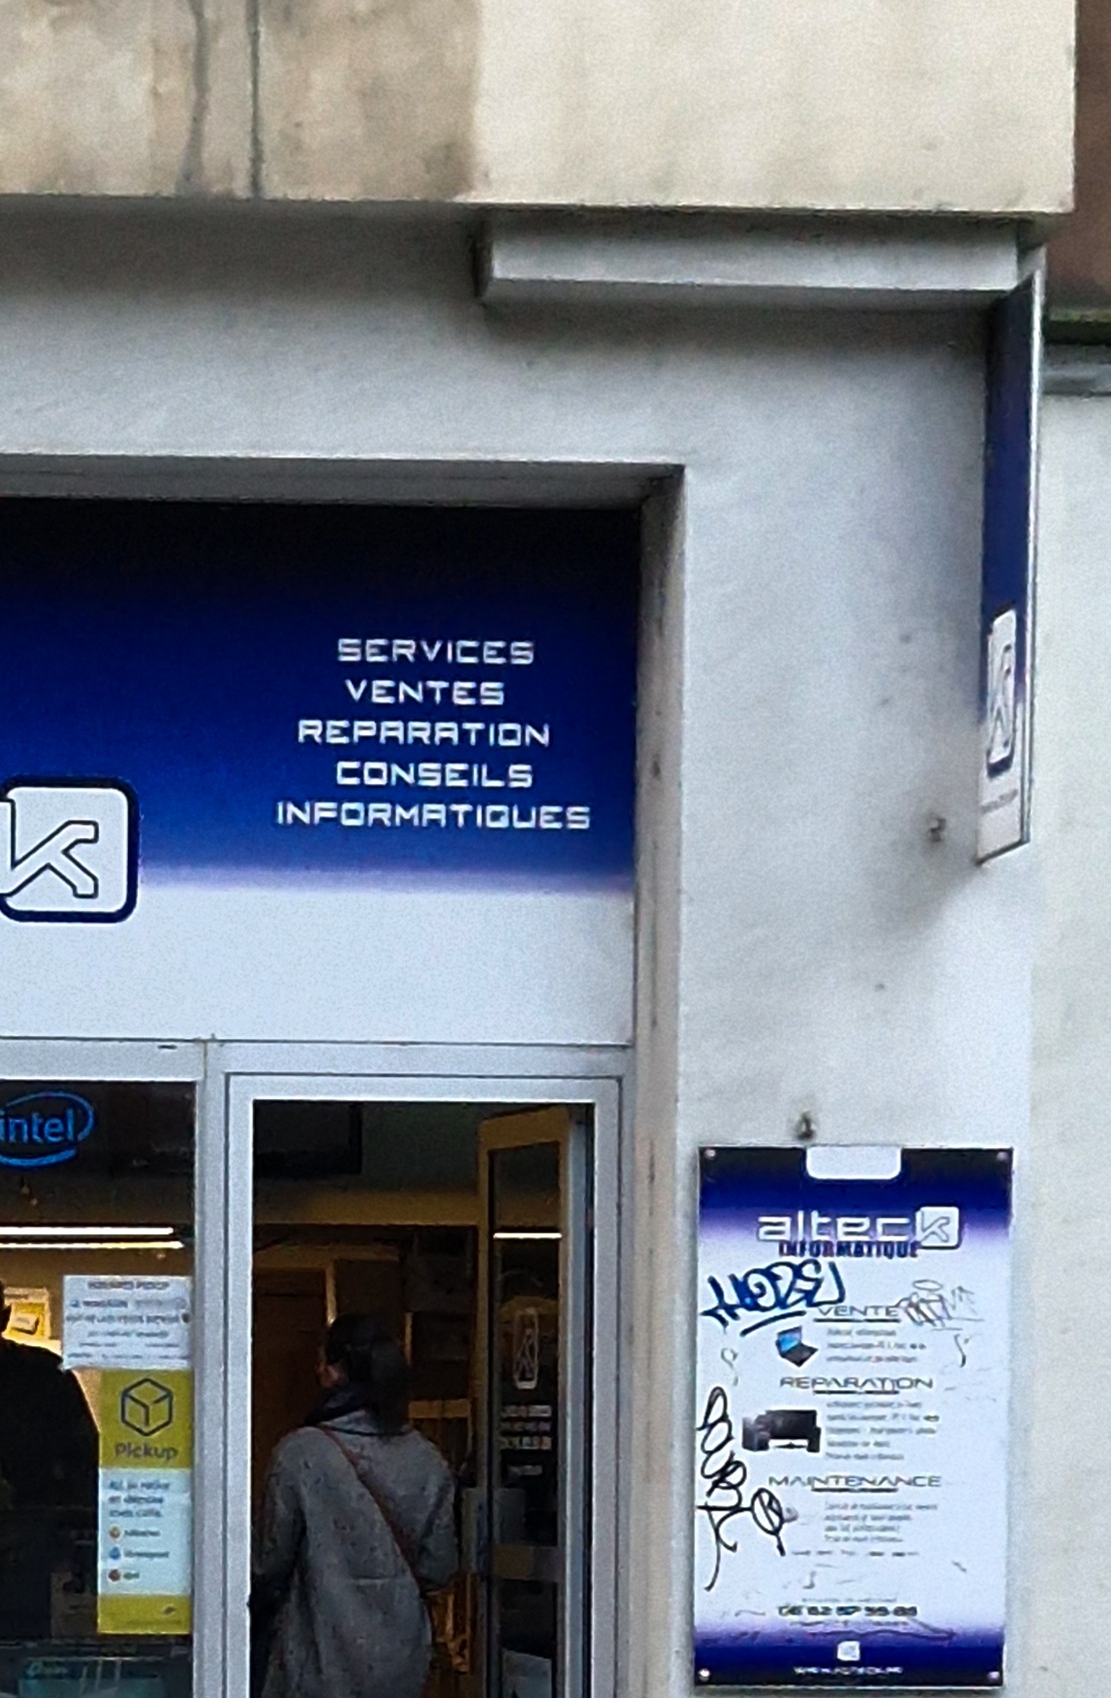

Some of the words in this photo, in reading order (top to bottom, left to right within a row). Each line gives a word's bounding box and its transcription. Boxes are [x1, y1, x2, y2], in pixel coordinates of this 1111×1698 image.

[337, 638, 534, 665] SERVICES
[345, 679, 505, 705] VENTES
[298, 719, 550, 746] REPARATION
[336, 761, 533, 788] CONSEILS
[276, 801, 590, 829] INFORMATIQUES
[818, 1304, 901, 1317] VENTE
[779, 1376, 934, 1390] REPARATION
[115, 1442, 179, 1461] Pickup
[768, 1475, 942, 1488] MAINTENANCE
